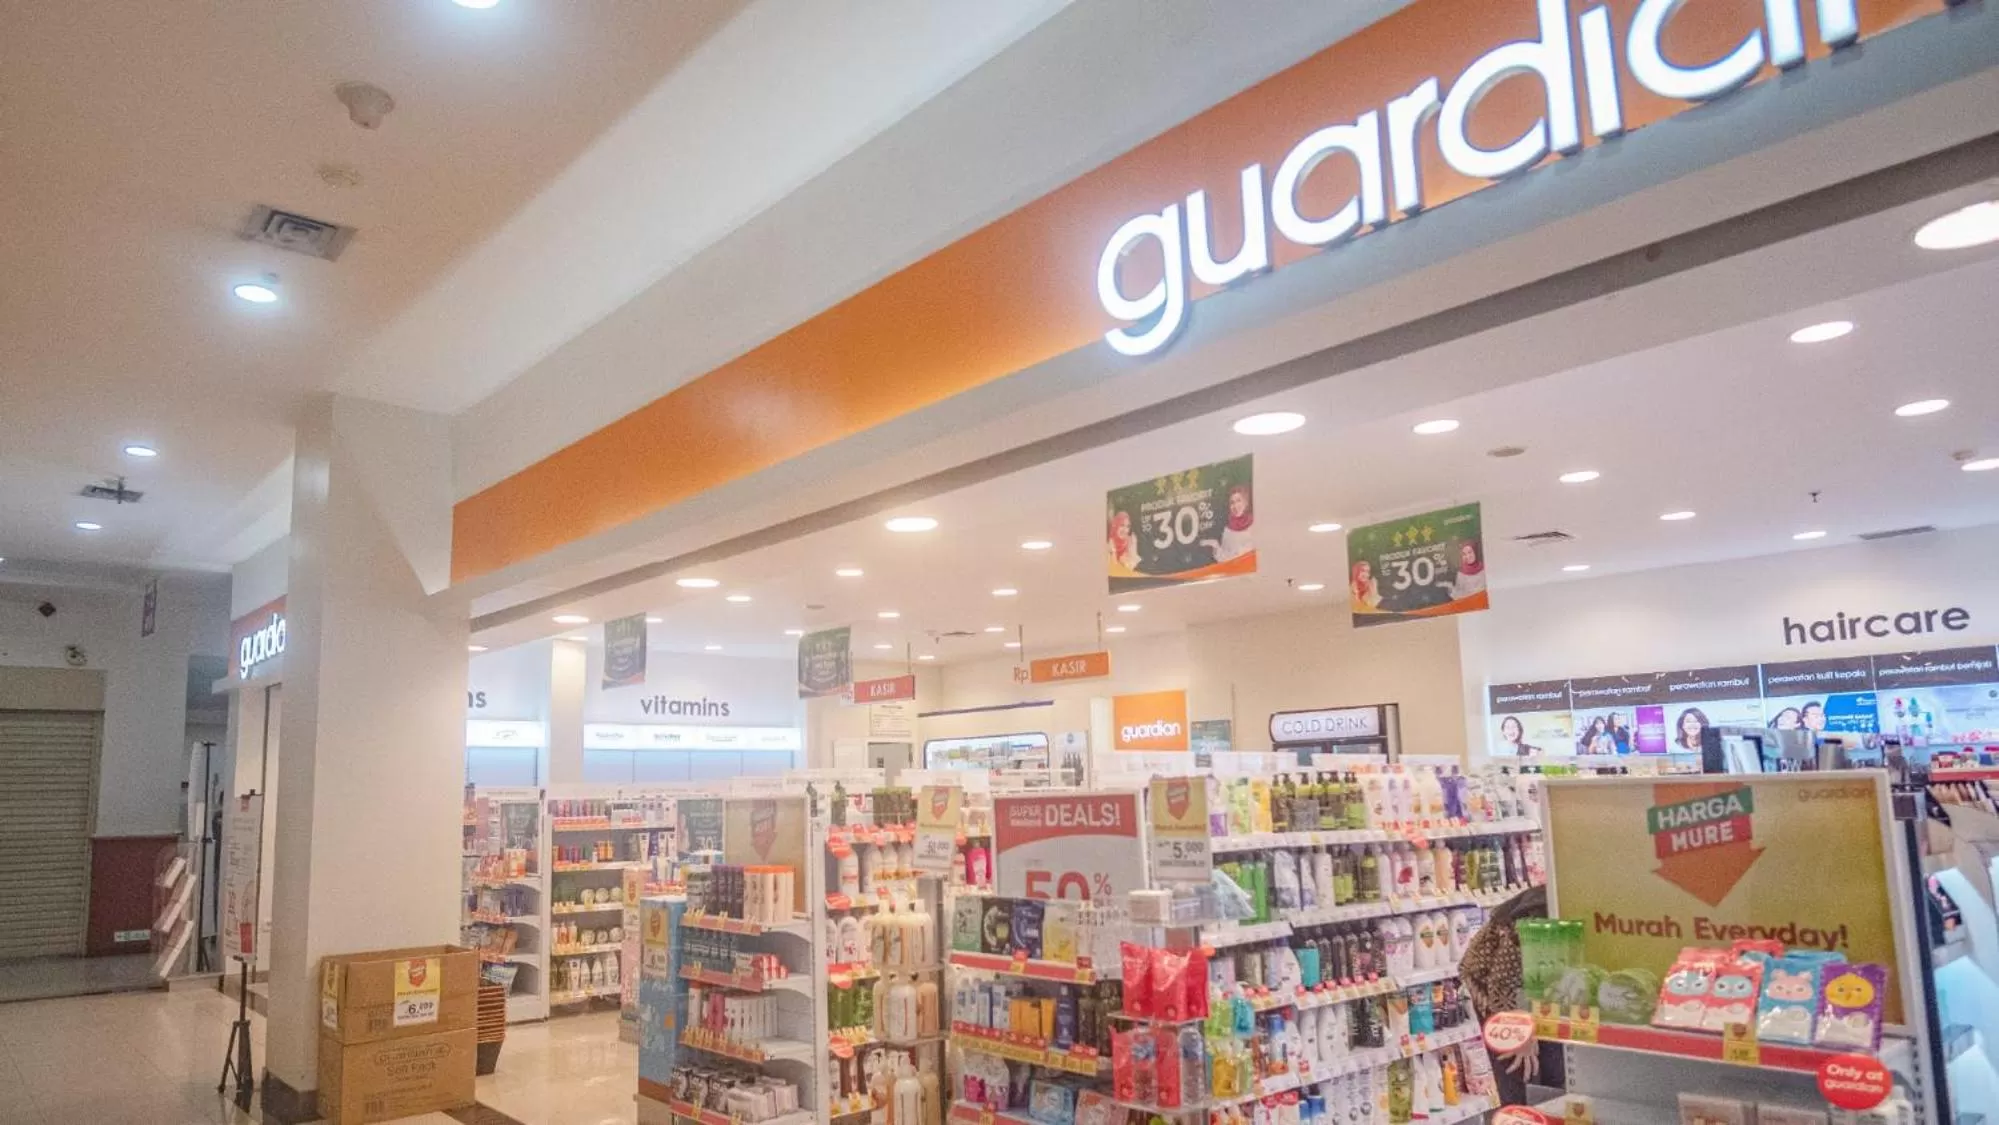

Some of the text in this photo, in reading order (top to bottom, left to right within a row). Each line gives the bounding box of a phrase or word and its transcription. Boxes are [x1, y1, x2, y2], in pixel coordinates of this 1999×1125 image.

[1095, 0, 1860, 356] guardia
[1783, 607, 1970, 645] haircare
[1052, 659, 1087, 674] KASIR
[870, 683, 896, 697] KASIR
[640, 696, 731, 717] vitamins
[1121, 718, 1181, 743] guardian
[1281, 716, 1368, 734] COLD DRINK
[1045, 802, 1121, 827] DEALS!
[1657, 793, 1744, 830] HARGA
[1671, 820, 1735, 852] MURE
[1593, 912, 1849, 951] Murah Everyday!
[1489, 1026, 1526, 1041] 40%
[1826, 1064, 1884, 1082] Only at
